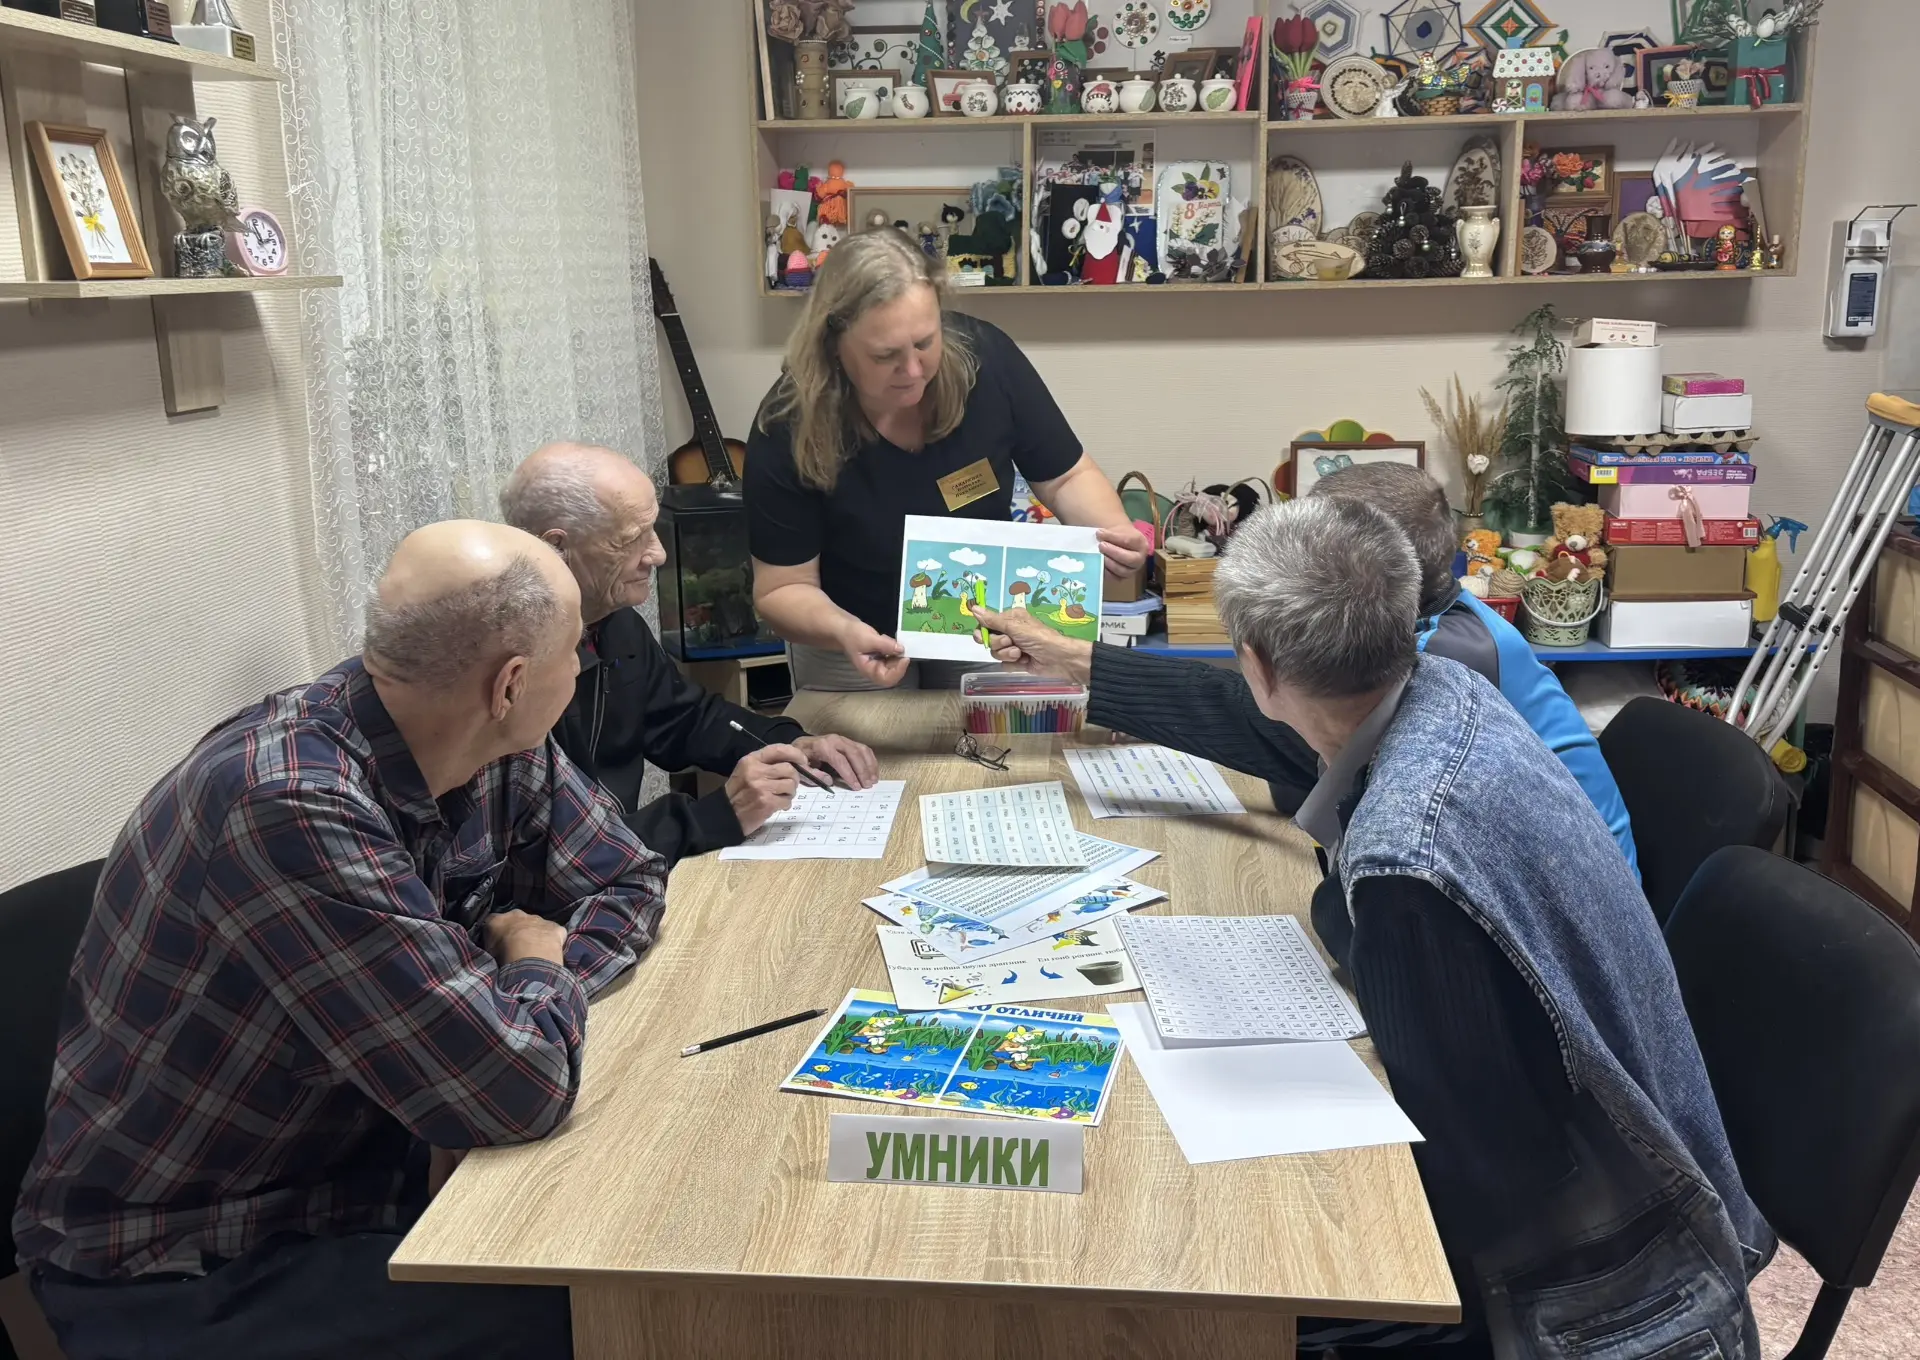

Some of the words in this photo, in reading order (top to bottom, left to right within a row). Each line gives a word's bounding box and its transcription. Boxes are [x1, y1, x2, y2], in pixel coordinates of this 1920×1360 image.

[1184, 202, 1195, 219] 8
[996, 1006, 1084, 1022] ОТЛИЧИЙ
[865, 1132, 1050, 1186] УМНИКИ
